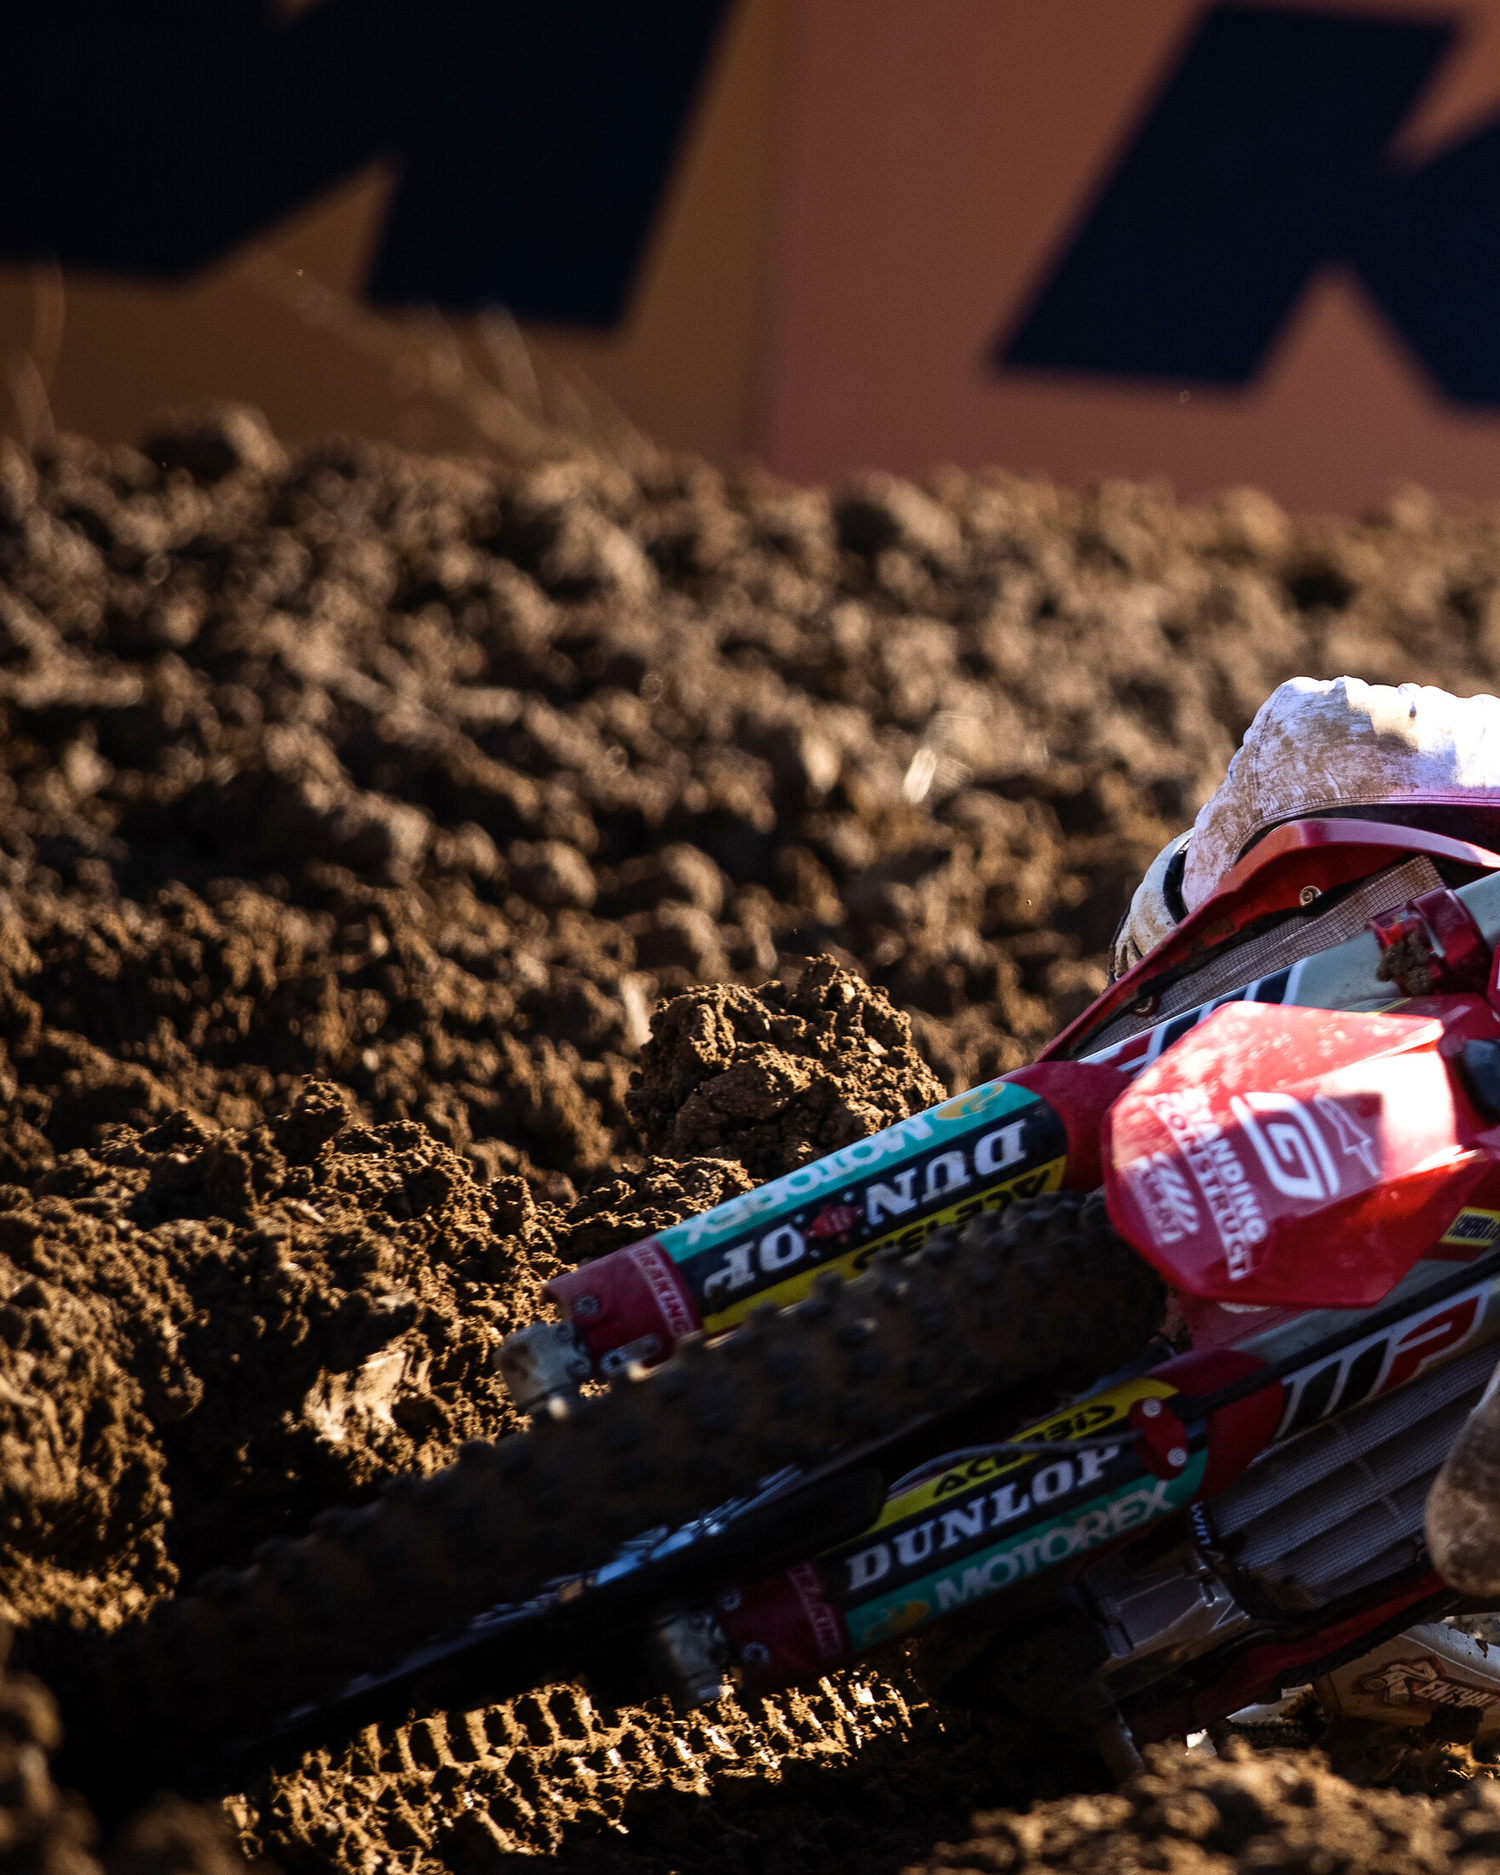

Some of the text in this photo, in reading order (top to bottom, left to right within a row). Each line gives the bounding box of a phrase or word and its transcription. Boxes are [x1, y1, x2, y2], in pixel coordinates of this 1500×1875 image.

[704, 1117, 1030, 1300] DUNOP
[845, 1443, 1122, 1595] DUNLOP
[934, 1480, 1176, 1613] MOTOREX
